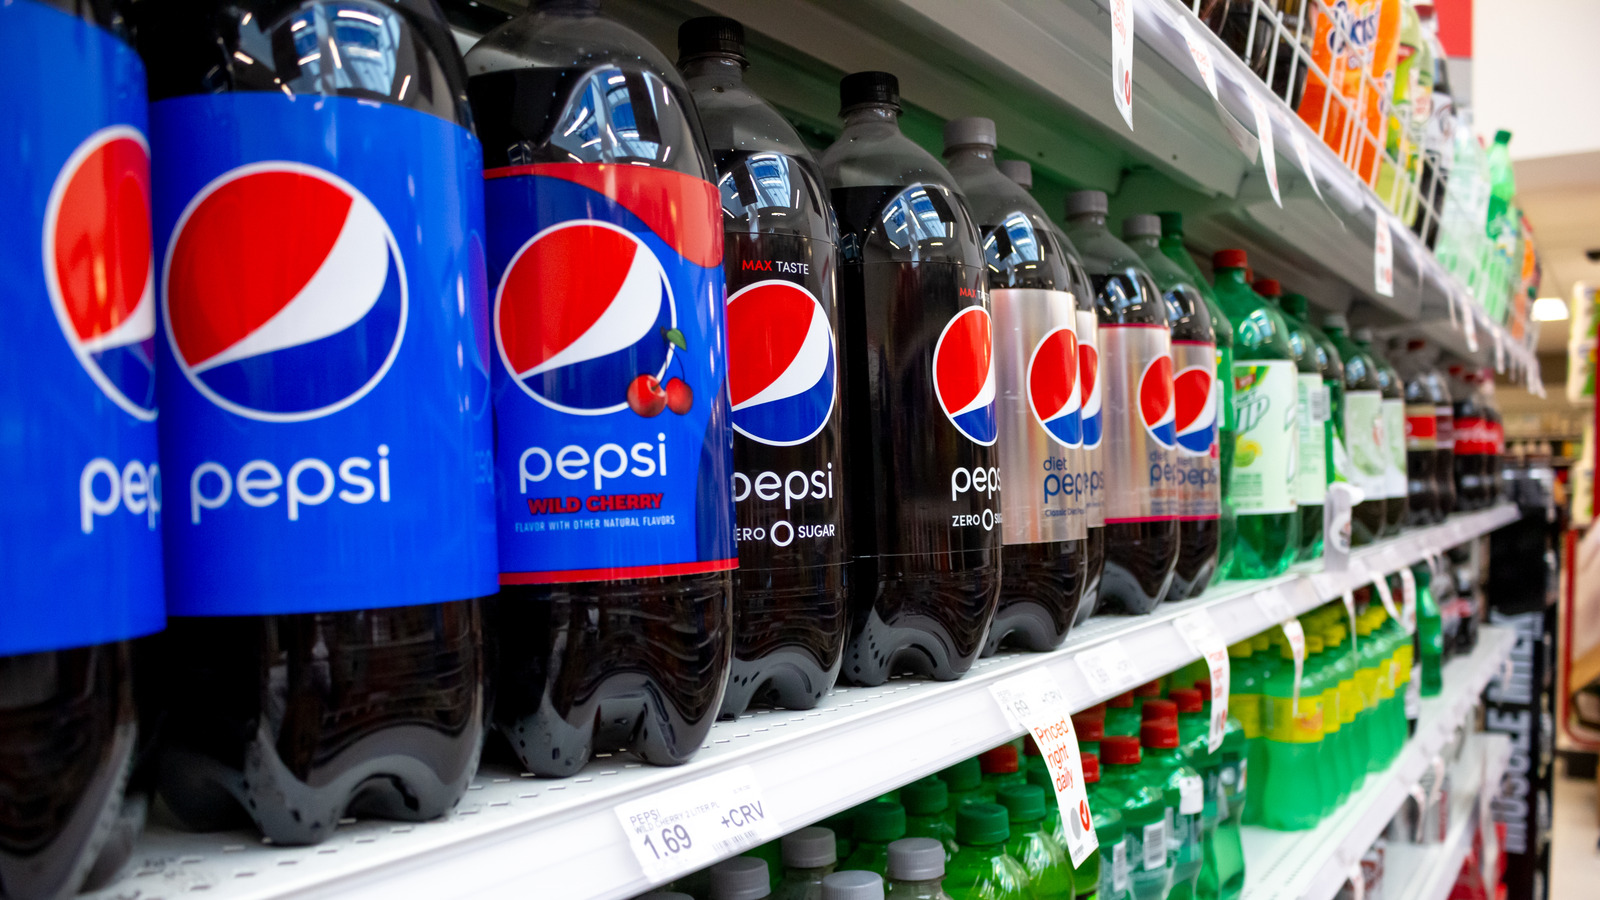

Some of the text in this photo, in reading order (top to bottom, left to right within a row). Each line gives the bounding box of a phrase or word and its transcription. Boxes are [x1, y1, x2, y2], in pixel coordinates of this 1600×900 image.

[742, 259, 809, 275] MAX TASTE
[960, 287, 977, 299] MAX
[518, 432, 667, 494] pepsi
[1043, 456, 1068, 471] diet
[191, 444, 391, 524] pepsi
[733, 462, 833, 510] pepsi
[527, 492, 664, 516] WILD CHERRY
[515, 515, 675, 533] FLAVOR WITH OTHER NATURAL FLAVORS
[735, 528, 766, 541] ERO
[798, 524, 835, 539] SUGAR
[952, 514, 981, 527] ZERO
[1034, 717, 1069, 746] Priced
[1047, 742, 1069, 770] right
[1056, 766, 1074, 793] daily
[630, 808, 661, 826] PEPSI
[635, 822, 654, 835] WILD
[655, 813, 684, 828] CHERRY
[685, 810, 691, 819] 2
[692, 803, 711, 817] LITER
[721, 800, 765, 829] +CRV
[644, 824, 693, 860] 1.69
